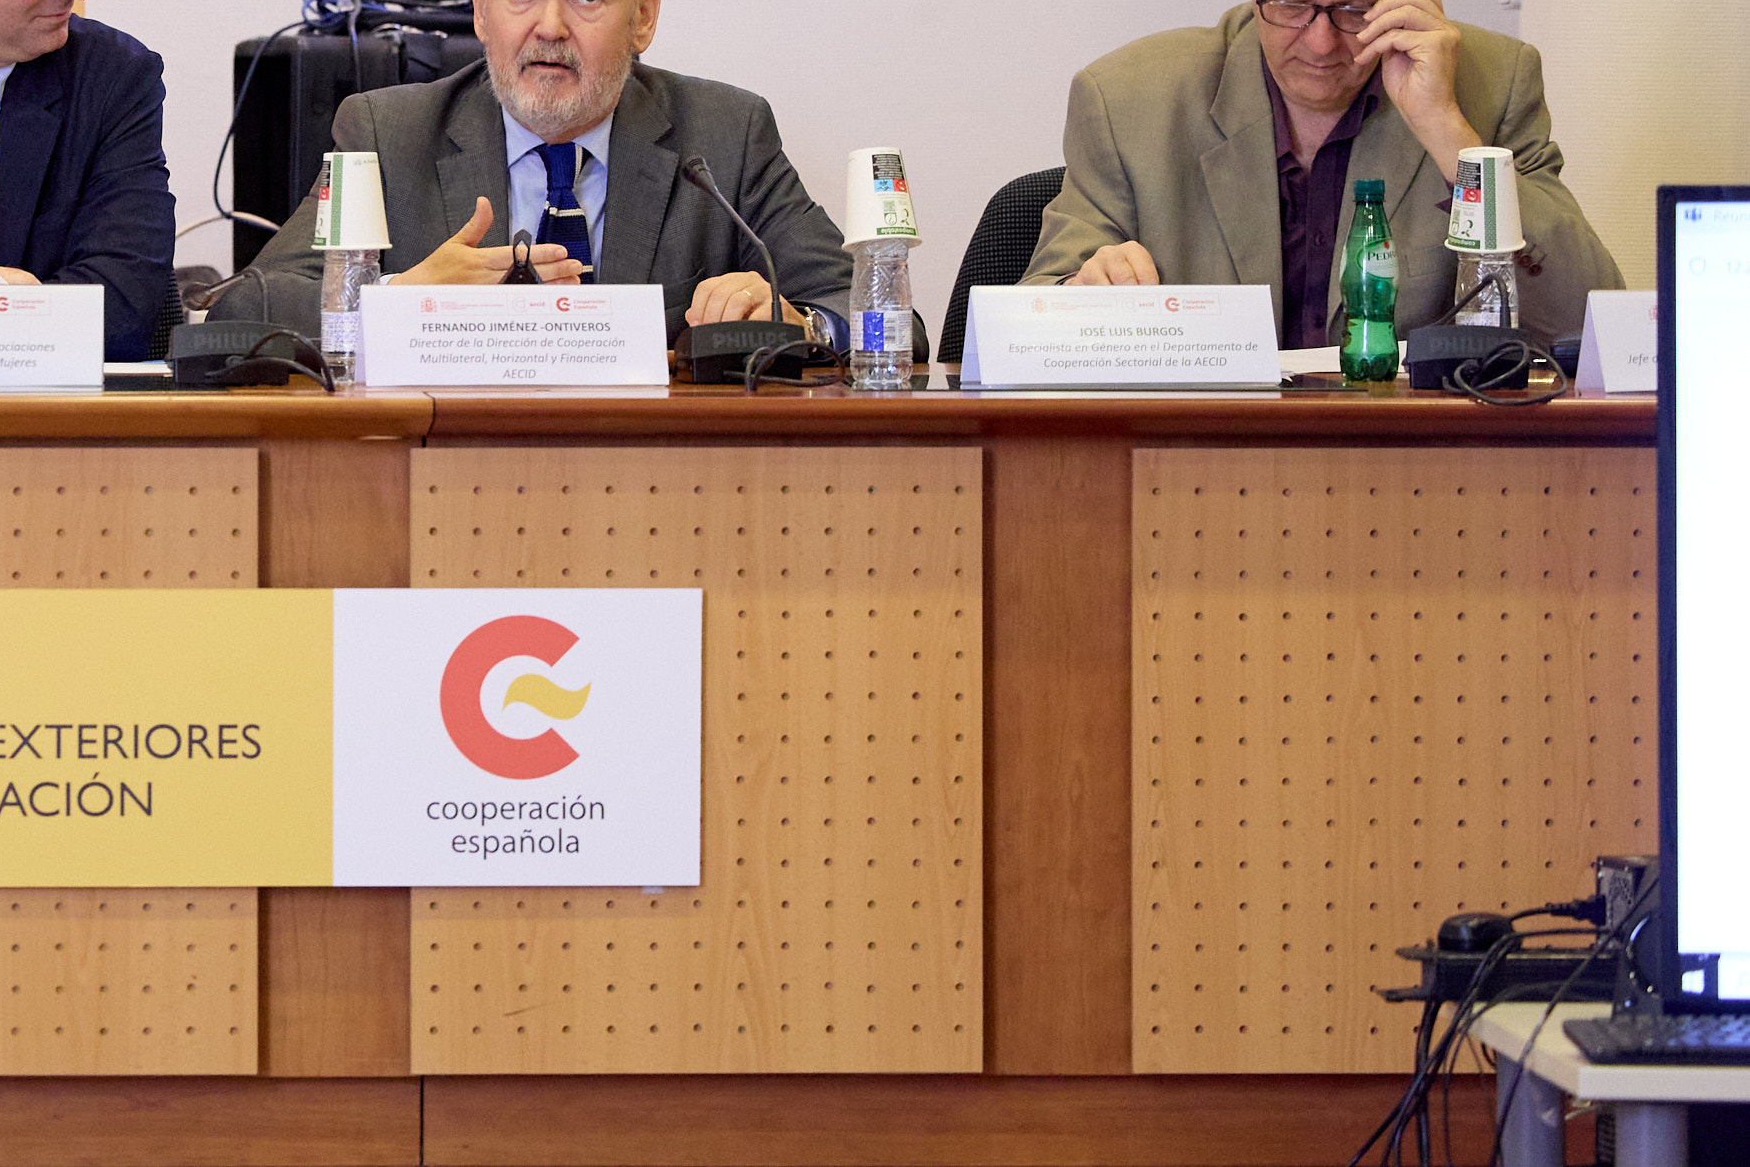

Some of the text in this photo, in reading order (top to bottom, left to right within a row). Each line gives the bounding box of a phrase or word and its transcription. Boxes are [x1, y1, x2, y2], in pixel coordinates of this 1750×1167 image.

[422, 321, 610, 332] FERNANDO JIMÉNEZ -ONTIVEROS
[1080, 326, 1183, 336] JOSÉ LUIS BURGOS
[409, 338, 625, 349] Director de la Dirección de Cooperación
[711, 331, 788, 349] PHILIPS
[1008, 341, 1258, 353] Especialista en Género en el Departamento de
[420, 353, 617, 365] Multilateral, Horizontal y Financiera
[1044, 357, 1227, 369] Cooperación Sectorial de la AECID
[1628, 353, 1649, 366] Jefe
[503, 370, 536, 378] AECID
[427, 795, 604, 829] cooperación
[452, 828, 579, 859] española
